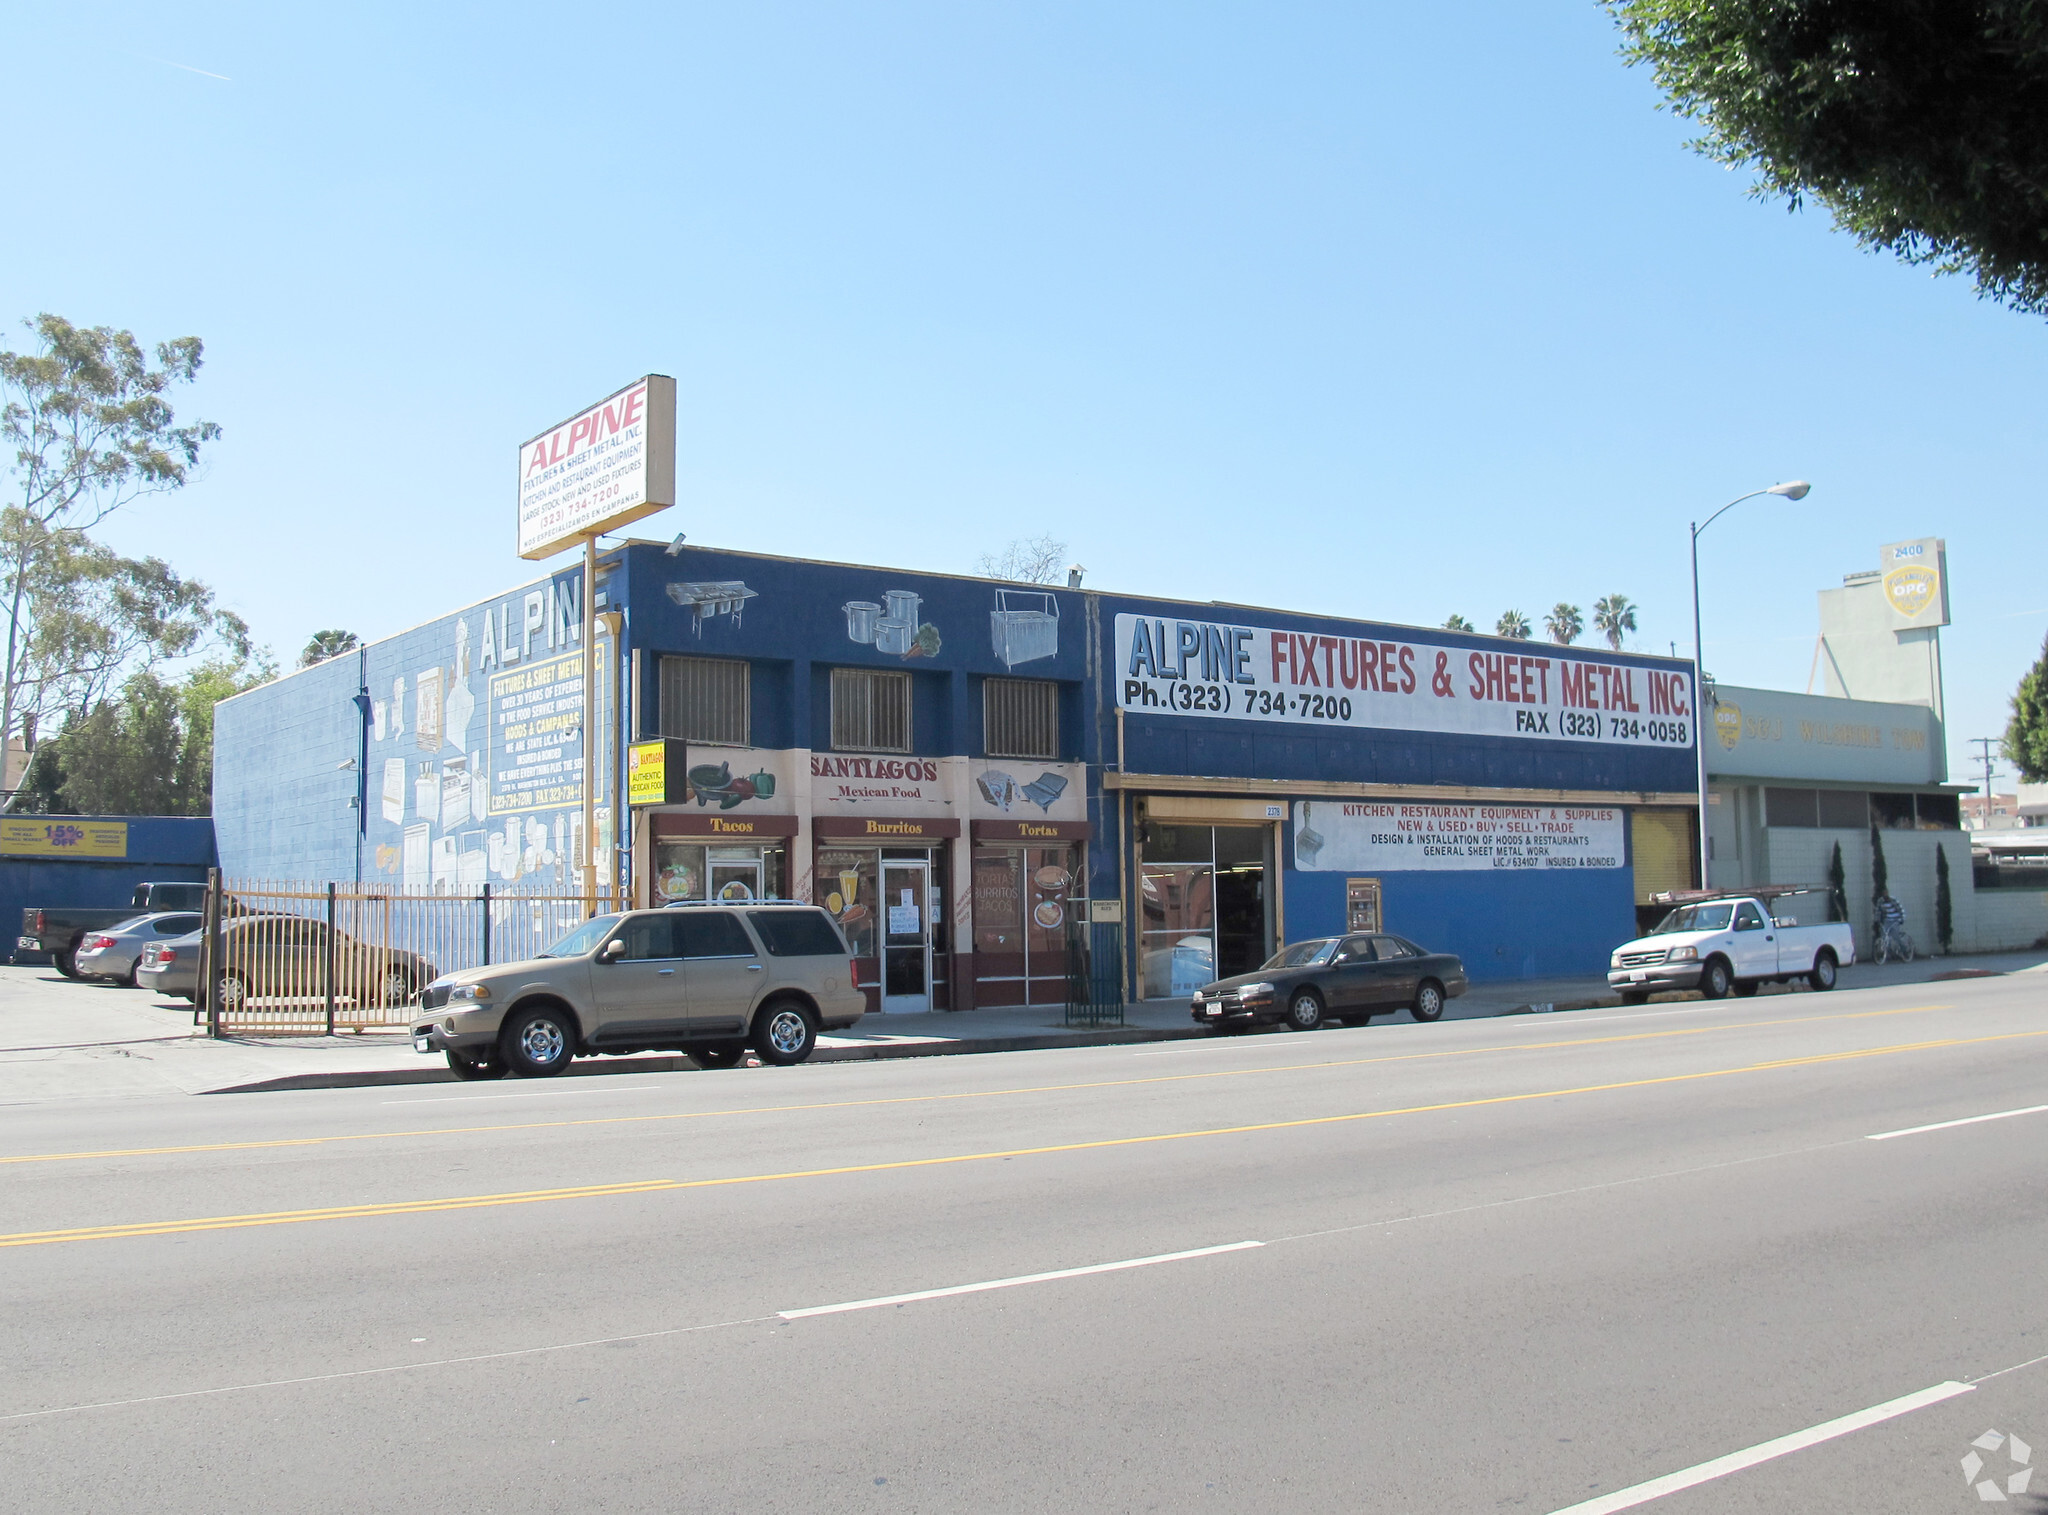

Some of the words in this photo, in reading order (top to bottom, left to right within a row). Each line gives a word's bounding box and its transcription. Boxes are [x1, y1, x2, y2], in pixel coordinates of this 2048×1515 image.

[526, 386, 646, 478] ALPINE
[524, 467, 558, 492] FIXTURES
[560, 463, 565, 474] &
[567, 449, 591, 470] SHEET
[625, 425, 642, 442] INC.
[523, 488, 547, 508] KITCHEN
[548, 481, 560, 495] AND
[563, 462, 602, 488] RESTAURANT
[603, 442, 642, 469] EQUIPMENT
[523, 507, 540, 522] LARGE
[577, 483, 591, 496] AND
[593, 474, 610, 489] USED
[612, 459, 642, 481] FIXTURES
[540, 509, 564, 529] (323)
[568, 484, 619, 515] 734-7200
[537, 513, 590, 542] ESPECIALIZAMOS
[592, 508, 601, 518] EN
[602, 491, 639, 514] CAMPANAS
[1895, 544, 1923, 558] 2400
[1894, 582, 1927, 596] OPG
[480, 571, 607, 669] ALPINE
[1128, 618, 1255, 685] ALPINE
[1270, 631, 1416, 695] FIXTURES
[1432, 651, 1455, 698] &
[1468, 652, 1550, 705] SHEET
[1561, 661, 1640, 713] METAL
[1648, 671, 1690, 717] INC.
[494, 674, 525, 697] FIXTURES
[526, 672, 533, 688] &
[533, 665, 555, 686] SHEET
[501, 696, 516, 710] OVER
[524, 689, 543, 705] YEARS
[545, 686, 553, 699] OF
[554, 678, 582, 697] EXPERIE
[506, 711, 516, 723] THE
[516, 707, 531, 721] FOOD
[532, 701, 555, 717] SERVICE
[556, 694, 583, 712] INDUSTR
[505, 723, 527, 740] HOODS
[528, 722, 535, 736] &
[536, 711, 580, 734] CAMPANAS
[1516, 710, 1549, 733] FAX
[1559, 711, 1601, 739] (323)
[1717, 712, 1737, 724] OPG
[1800, 719, 1882, 748] WILSHIRE
[1891, 727, 1926, 751] TOW
[506, 743, 514, 754] WE
[515, 740, 525, 752] ARE
[526, 737, 543, 750] STATE
[499, 770, 507, 781] WE
[507, 769, 520, 780] HAVE
[520, 764, 550, 779] EVERYTHING
[550, 762, 562, 773] PLUS
[563, 760, 573, 771] THE
[632, 771, 662, 782] AUTHENTIC
[810, 756, 938, 782] SANTIAGO'S
[536, 788, 549, 804] FAX
[550, 784, 582, 802] 323-734-
[630, 783, 649, 792] MEXICAN
[650, 781, 664, 790] FOOD
[838, 785, 888, 798] Mexican
[891, 786, 922, 799] Food
[1343, 804, 1395, 817] KITCHEN
[1401, 806, 1475, 818] RESTAURANT
[1481, 808, 1541, 820] EQUIPMENT
[1550, 809, 1557, 820] &
[1565, 809, 1613, 820] SUPPLIES
[44, 825, 84, 838] 15%
[710, 818, 753, 832] Tacos
[866, 820, 923, 835] Burritos
[1019, 823, 1058, 836] Tortas
[1397, 820, 1422, 832] NEW
[1427, 821, 1434, 832] &
[52, 838, 75, 846] OFF
[1371, 834, 1403, 844] DESIGN
[1408, 834, 1413, 844] &
[1417, 834, 1479, 845] INSTALLATION
[1483, 835, 1493, 845] OF
[1496, 836, 1523, 845] HOODS
[1526, 836, 1532, 845] &
[1534, 836, 1589, 846] RESTAURANTS
[1424, 845, 1464, 856] GENERAL
[1468, 846, 1493, 856] SHEET
[1497, 846, 1522, 856] METAL
[1527, 847, 1550, 856] WORK
[1546, 858, 1576, 867] INSURED
[1579, 858, 1585, 866] &
[1586, 857, 1615, 866] BONDED
[976, 872, 1016, 885] TORTAS
[975, 887, 1018, 898] BURRITOS
[931, 908, 939, 918] A
[979, 900, 1012, 911] TACOS
